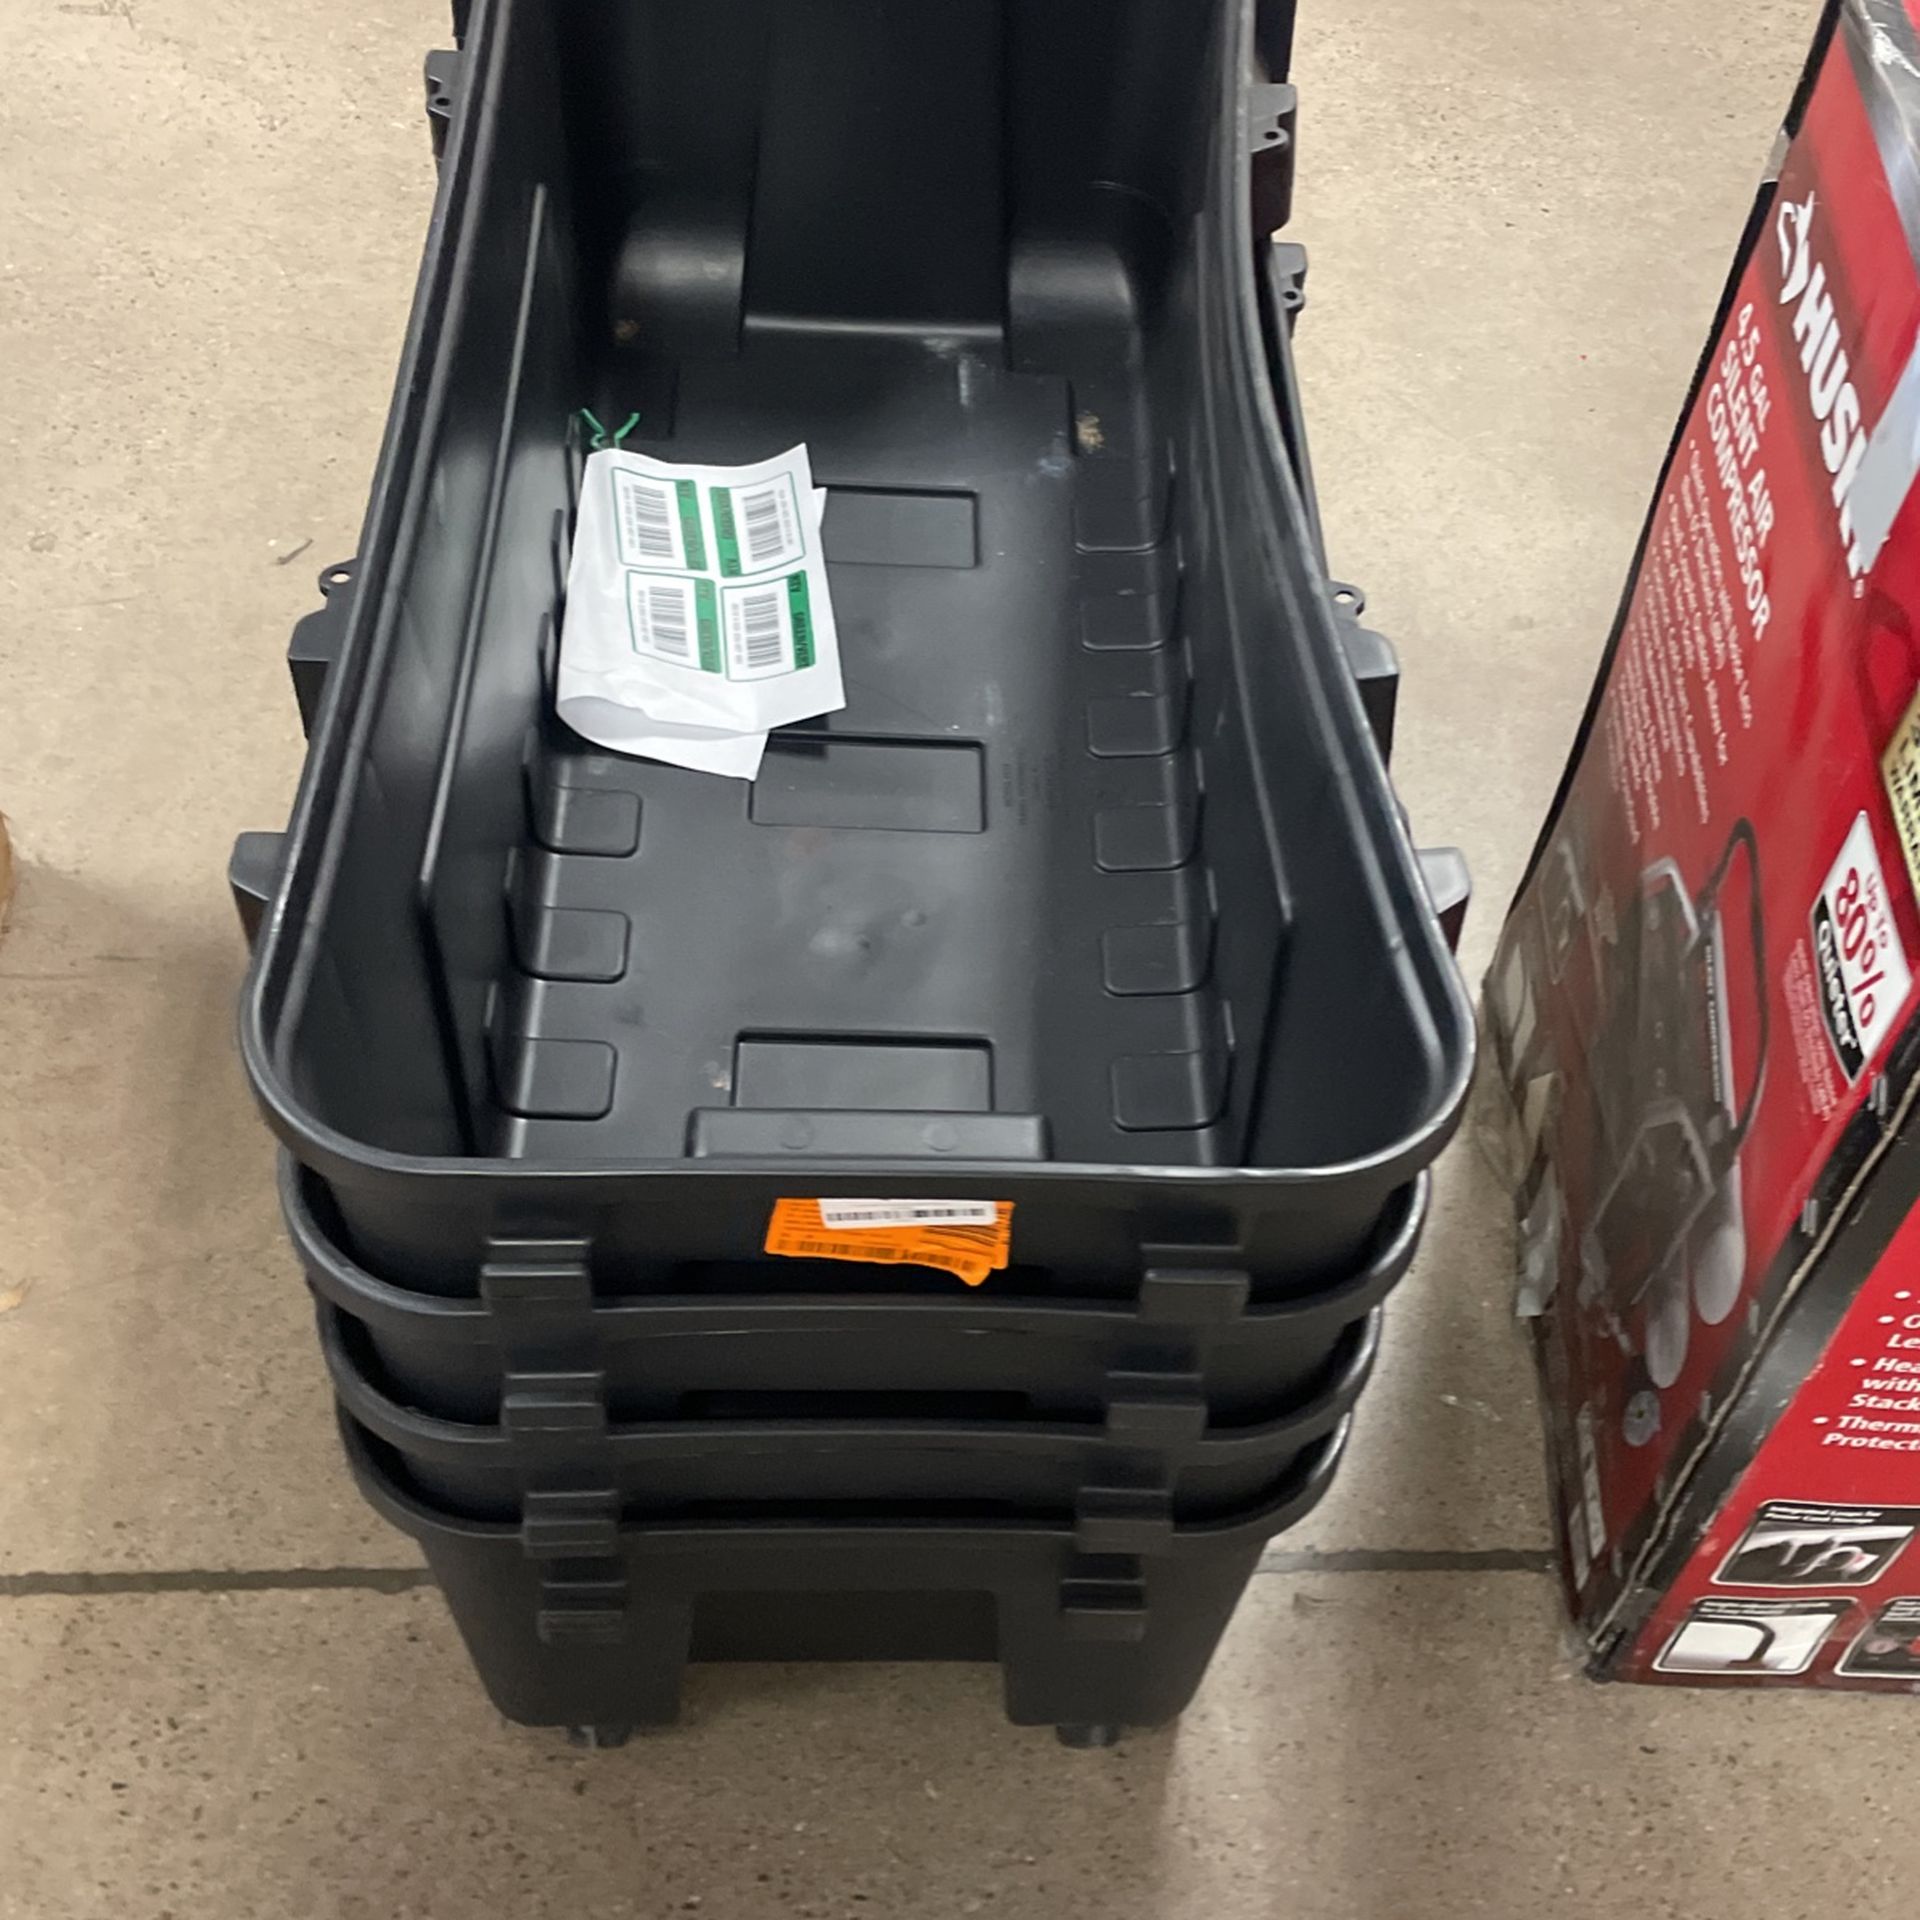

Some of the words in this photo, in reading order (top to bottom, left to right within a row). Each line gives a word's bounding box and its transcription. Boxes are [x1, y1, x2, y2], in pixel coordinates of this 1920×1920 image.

[1720, 339, 1759, 469] SILENT
[1747, 468, 1775, 547] AIR
[1749, 364, 1771, 432] GAL
[1706, 382, 1772, 641] COMPRESSOR
[1836, 867, 1885, 1028] 80%
[1862, 1376, 1920, 1393] with
